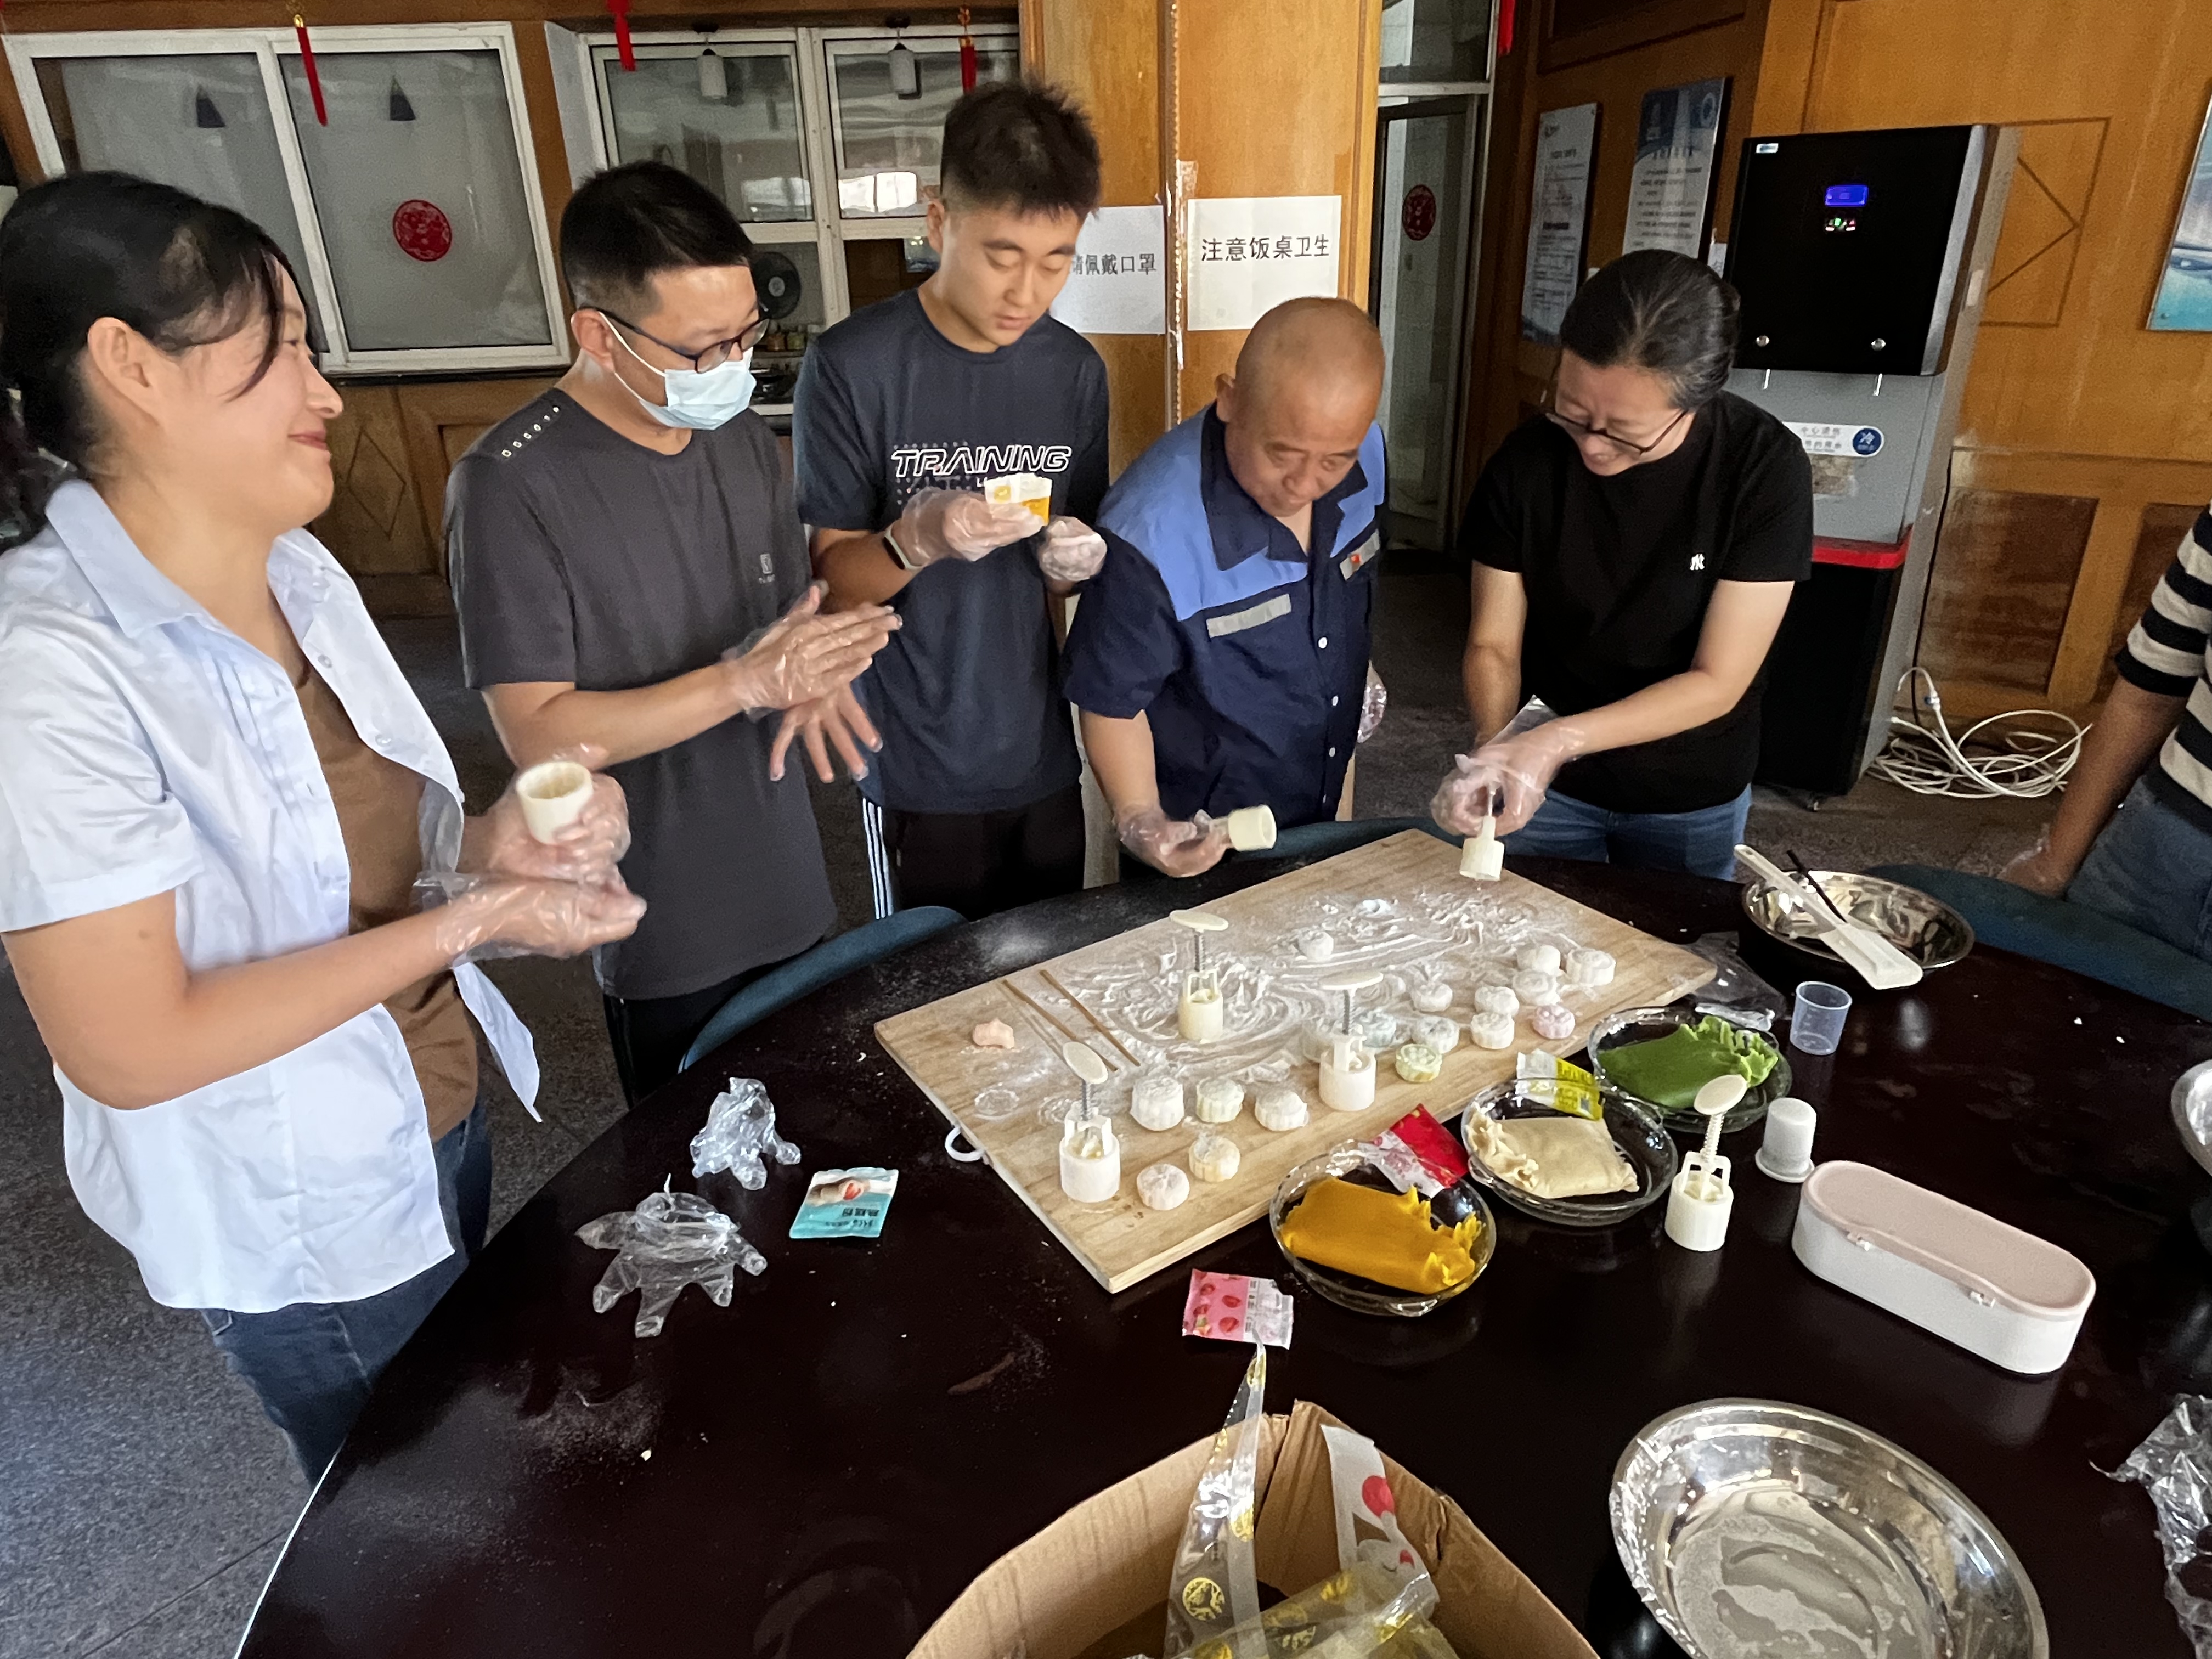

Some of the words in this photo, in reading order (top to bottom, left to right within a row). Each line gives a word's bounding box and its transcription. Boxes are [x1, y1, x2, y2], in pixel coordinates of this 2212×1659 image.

[1201, 234, 1330, 261] 注意饭桌卫生
[891, 444, 1072, 477] TRAINING
